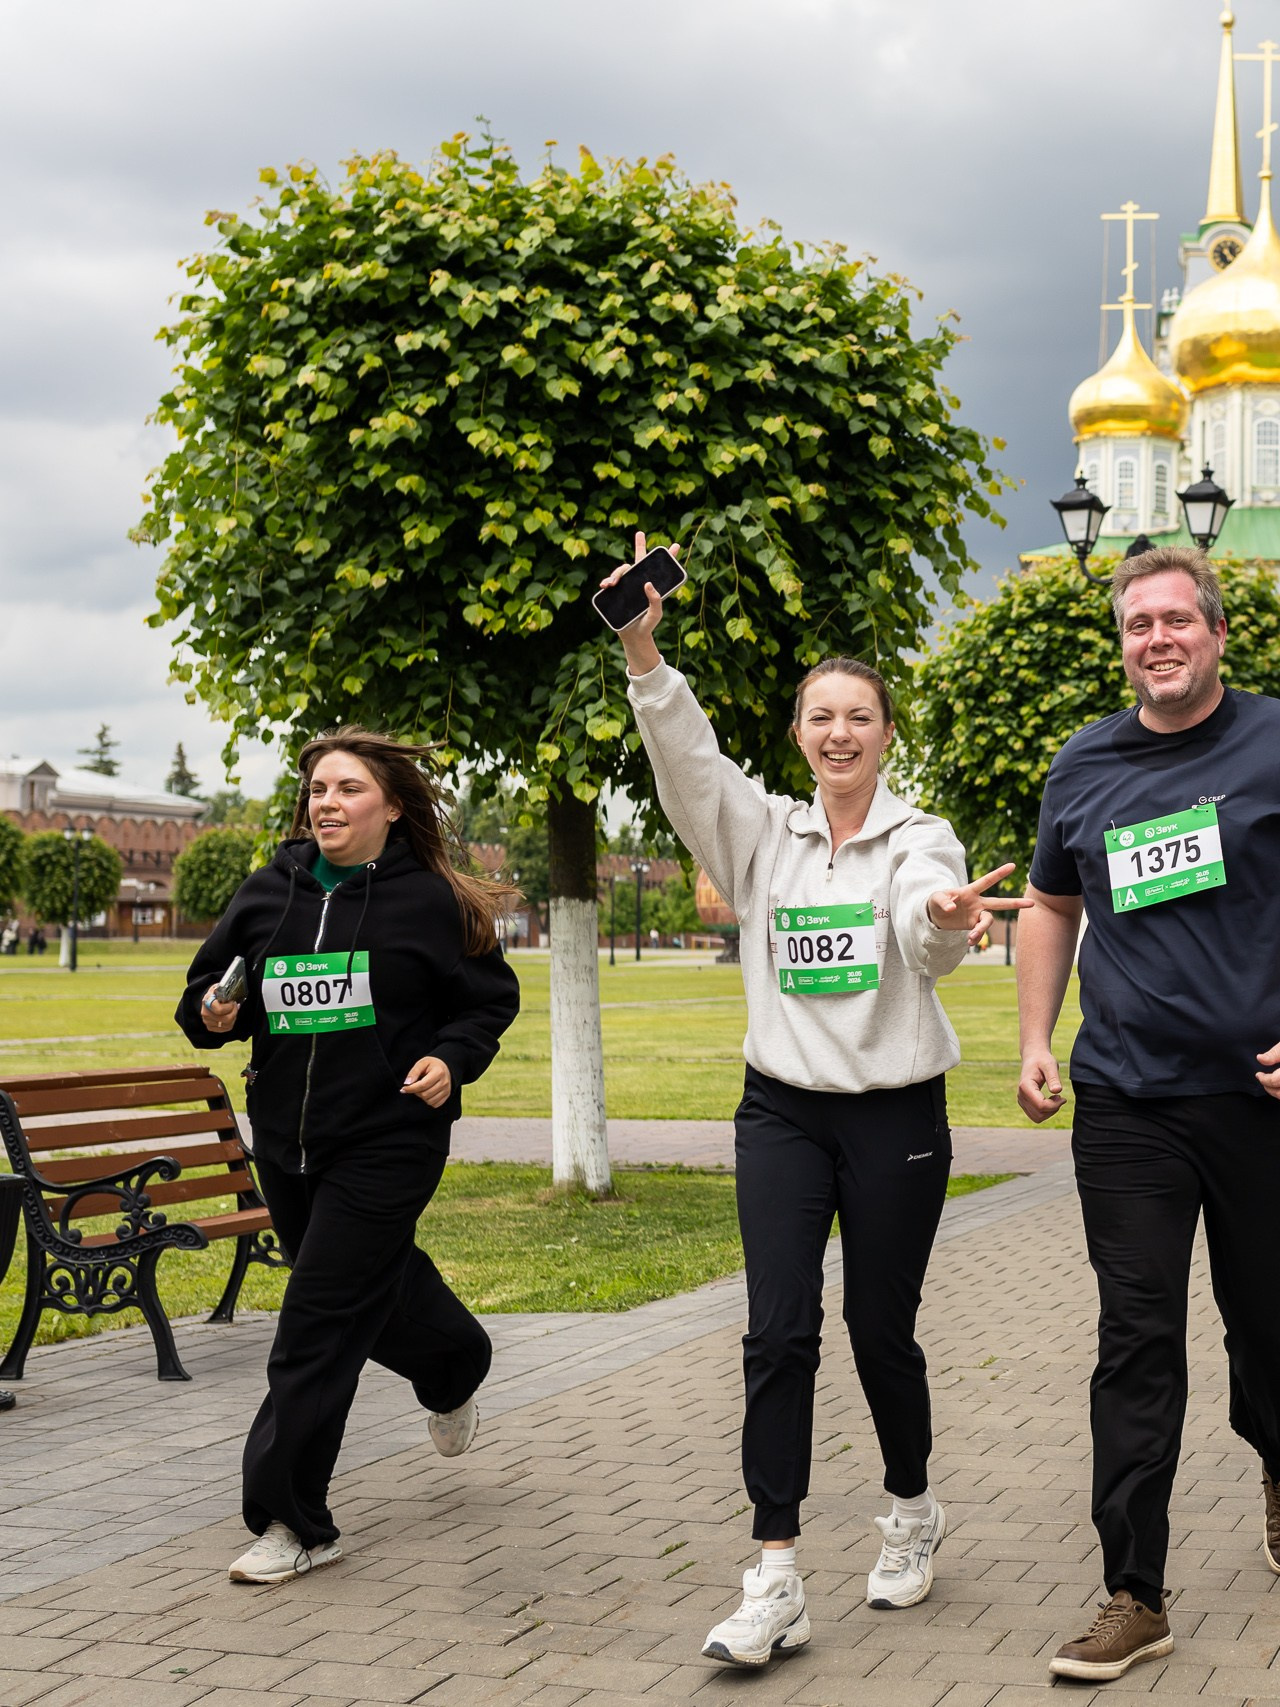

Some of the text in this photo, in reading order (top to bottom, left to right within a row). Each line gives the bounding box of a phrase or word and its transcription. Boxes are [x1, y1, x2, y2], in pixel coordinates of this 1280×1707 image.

[1156, 823, 1178, 834] Звук
[1130, 835, 1202, 878] 1375
[1124, 887, 1139, 907] A
[806, 915, 830, 925] Звук
[787, 932, 855, 964] 0082
[306, 962, 329, 972] Звук
[786, 971, 796, 989] A
[280, 979, 350, 1007] 0807
[277, 1013, 291, 1030] A
